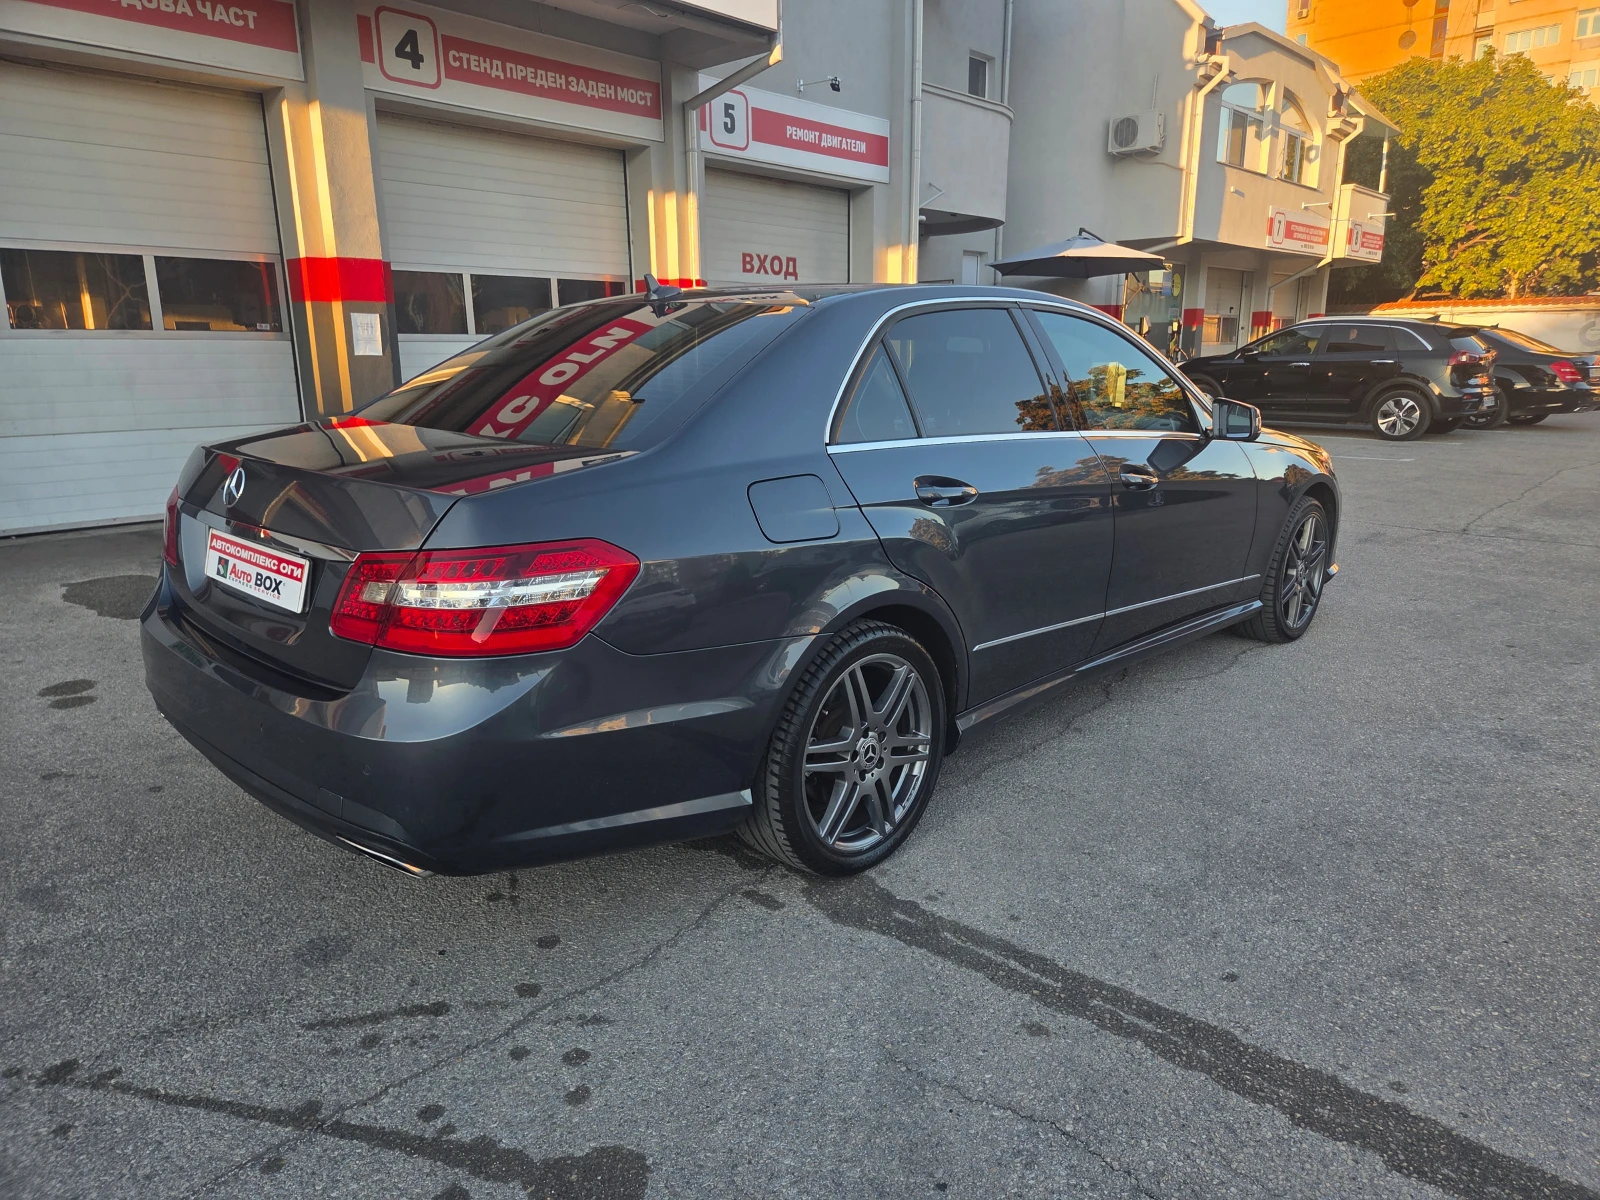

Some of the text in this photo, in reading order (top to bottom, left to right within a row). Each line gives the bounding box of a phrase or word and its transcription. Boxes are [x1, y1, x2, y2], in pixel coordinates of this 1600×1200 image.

[196, 0, 257, 29] ЧАСТ
[394, 28, 424, 70] 4
[448, 50, 652, 107] СТЕНД ПРЕДЕН ЗАДЕН МОСТ
[723, 102, 736, 134] 5
[786, 125, 866, 154] РЕМОНТ ДВИГАТЕЛИ
[741, 252, 798, 281] ВХОД
[211, 538, 302, 579] АВТОКОМПЛЕКС ОГИ
[228, 576, 281, 600] EXPRESS SERVICE
